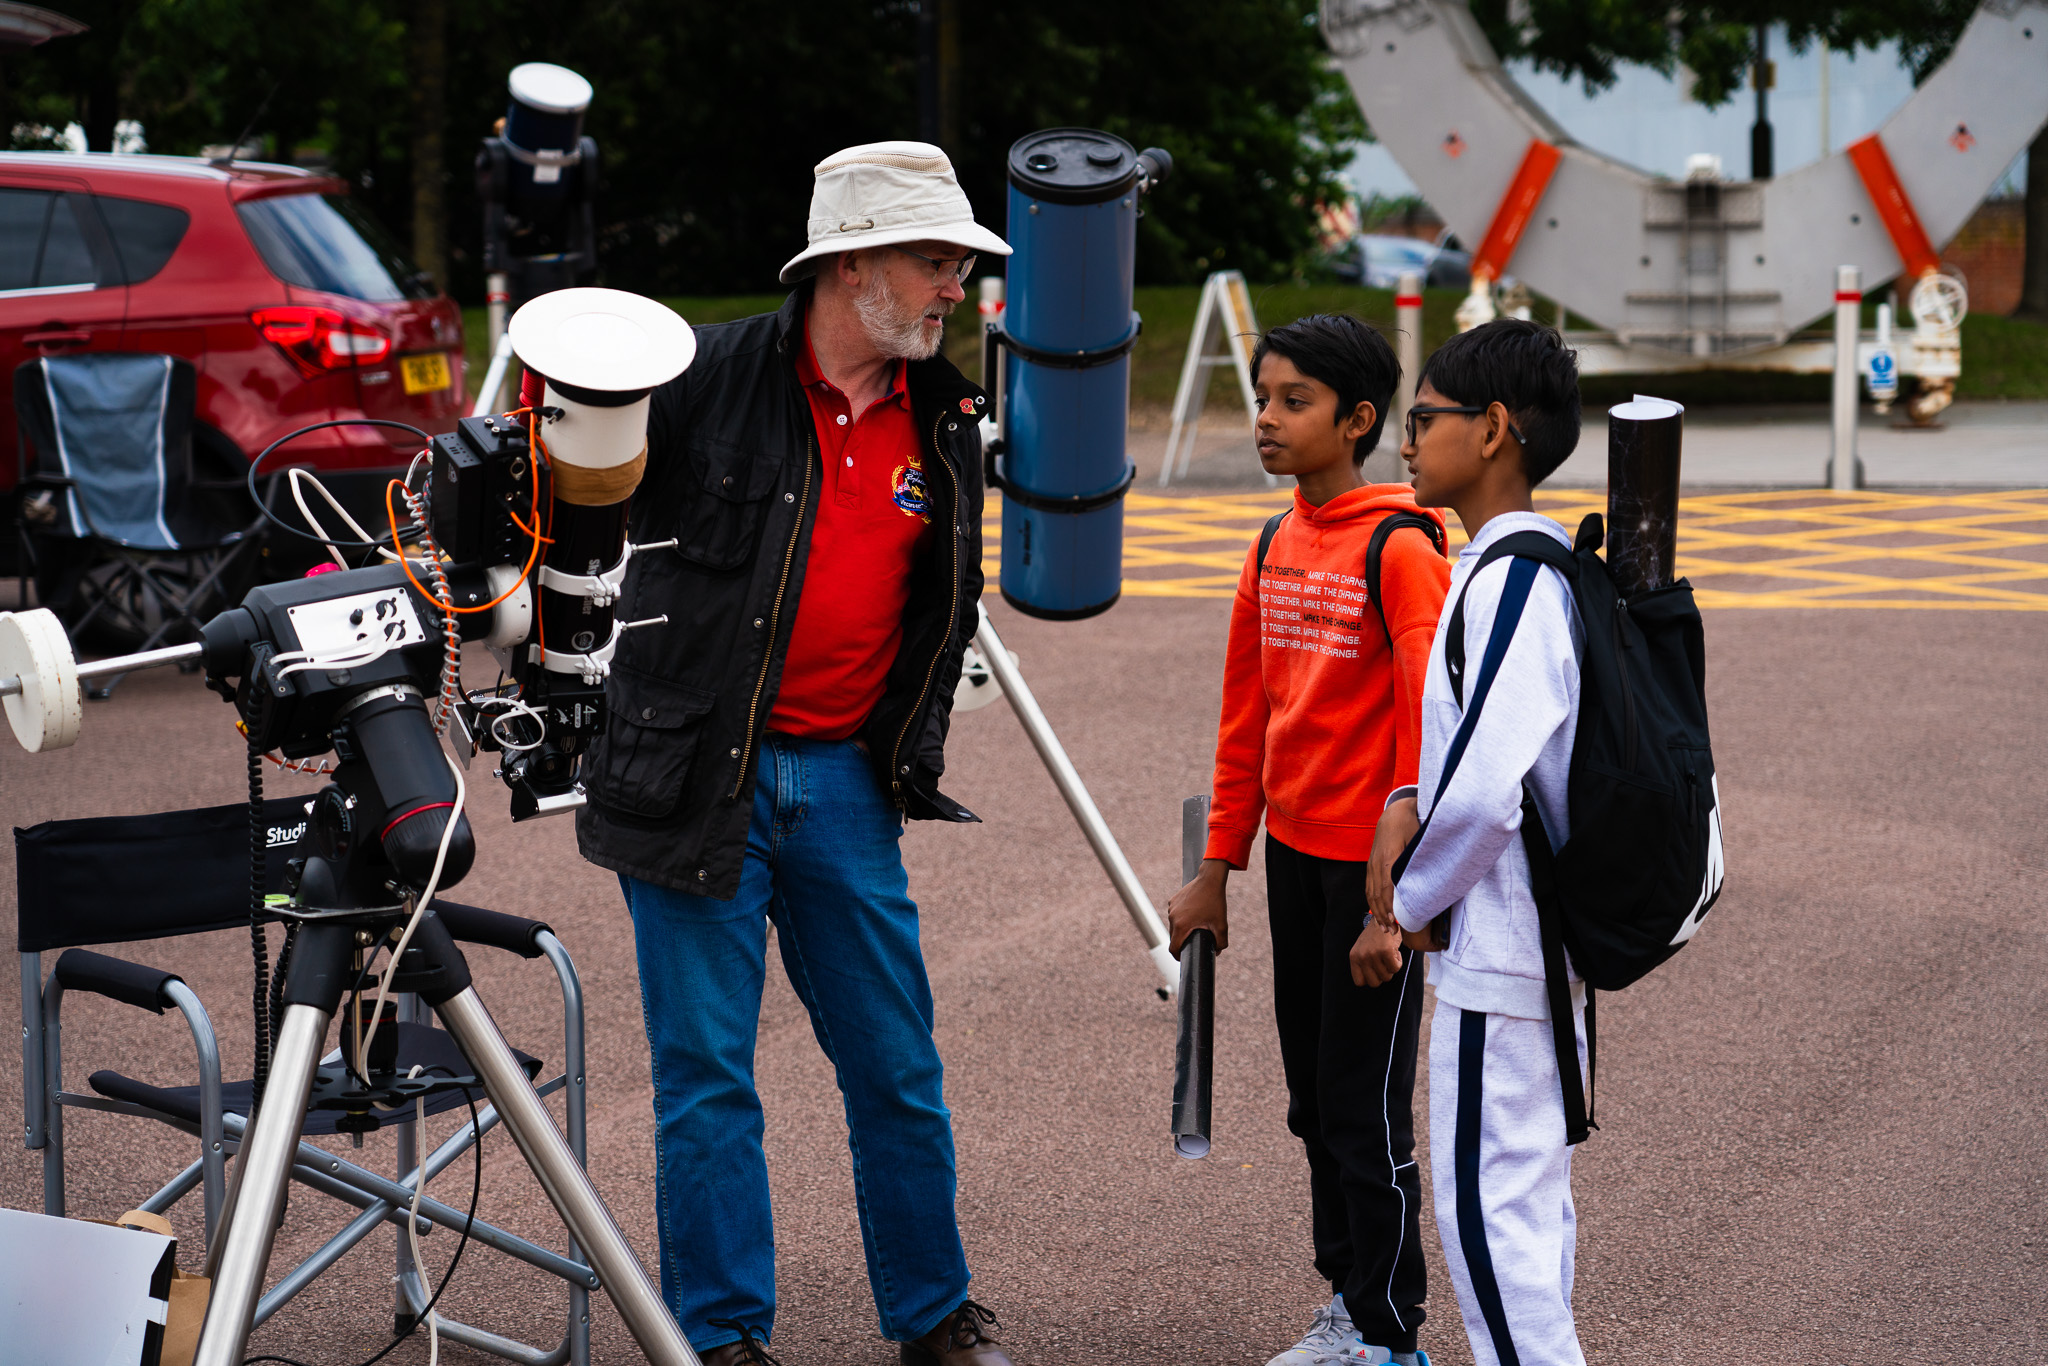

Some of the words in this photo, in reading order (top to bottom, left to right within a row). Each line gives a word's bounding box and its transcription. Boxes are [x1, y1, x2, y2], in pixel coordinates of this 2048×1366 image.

[1274, 566, 1306, 578] TOGETHER.
[1308, 571, 1326, 581] MAKE
[1327, 572, 1340, 583] THE
[1341, 575, 1368, 589] CHANG
[1271, 580, 1303, 593] TOGETHER.
[1304, 584, 1322, 595] MAKE
[1324, 587, 1338, 597] THE
[1338, 589, 1368, 603] CHANGE
[1270, 594, 1302, 607] TOGETHER.
[1303, 599, 1321, 610] MAKE
[1322, 601, 1335, 612] THE
[1336, 603, 1364, 617] CHANGE
[1269, 609, 1302, 621] TOGETHER.
[1304, 613, 1320, 624] MAKE
[1321, 616, 1334, 626] THE
[1268, 623, 1303, 635] TOGETHER.
[1303, 627, 1320, 638] MAKE
[1321, 630, 1331, 641] THE
[1330, 632, 1362, 645] CHANGE.
[1268, 637, 1303, 650] TOGETHER.
[1303, 641, 1319, 653] MAKE
[1320, 644, 1328, 655] THE
[1326, 646, 1360, 659] CHANGE.
